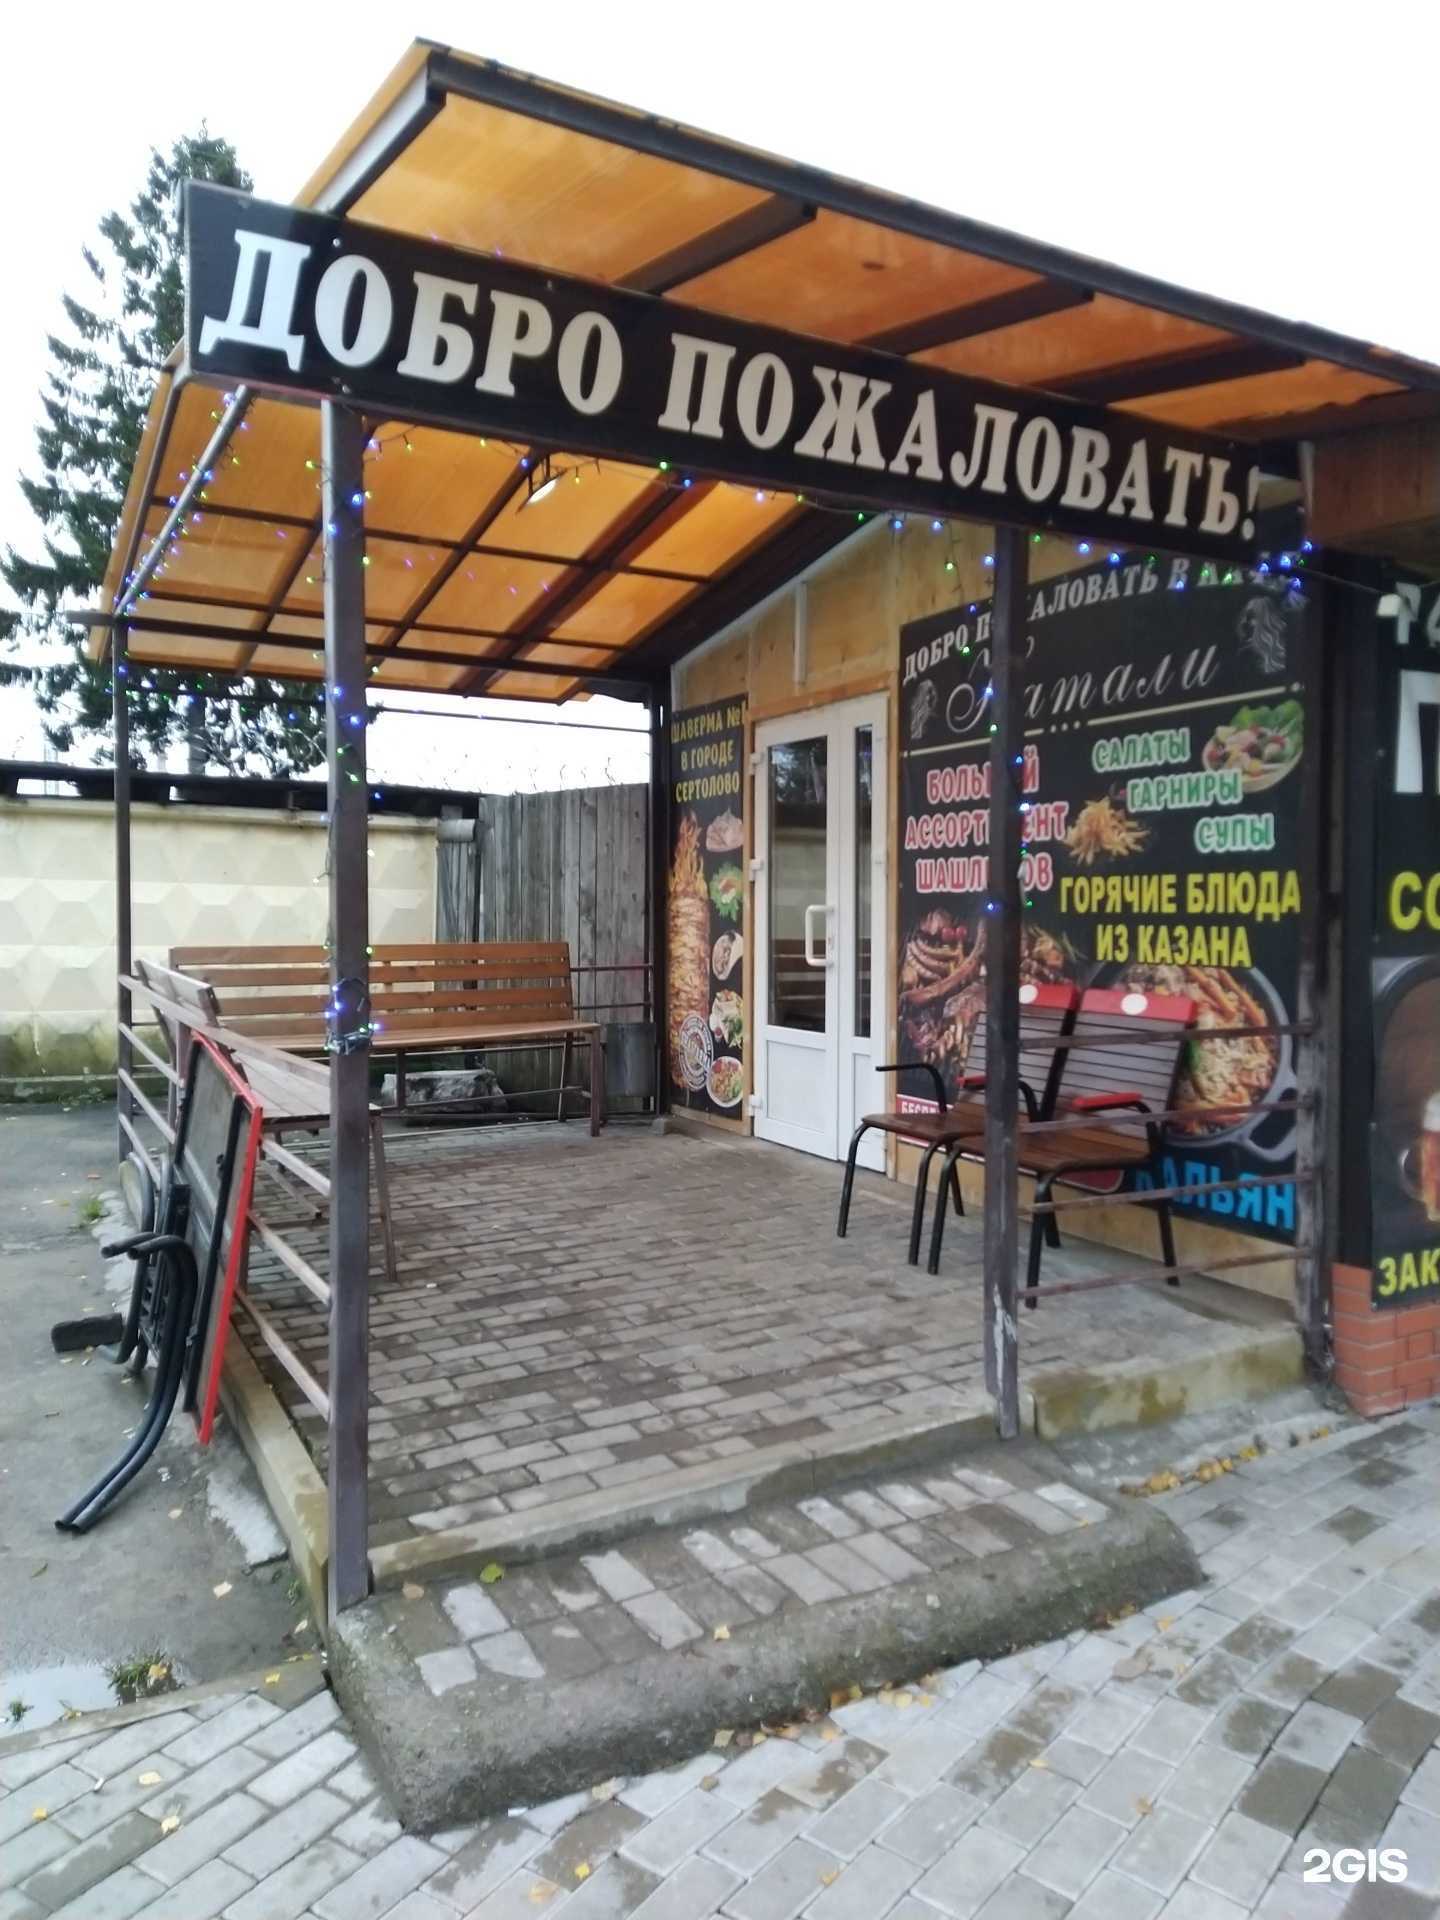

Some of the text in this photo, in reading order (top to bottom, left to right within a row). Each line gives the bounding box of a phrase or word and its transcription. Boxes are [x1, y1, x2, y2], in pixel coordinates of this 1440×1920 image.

[199, 229, 1260, 541] ДОБРО ПОЖАЛОВАТЬ!
[902, 624, 969, 686] ДОБРО
[975, 560, 1159, 643] ПАЛОВАТЬ
[671, 711, 723, 744] ШАВЕРМА
[691, 740, 734, 769] ГОРОДЕ
[1092, 727, 1191, 773] САЛАТЫ
[675, 771, 740, 803] СЕРТОЛОВО
[927, 744, 1039, 804] БОЛЬЙ
[1127, 769, 1243, 812] ГАРНИРЫ
[904, 801, 1069, 849] АССОРТЕНТ
[1194, 813, 1275, 853] СУПЫ
[916, 853, 1053, 893] ШАШЛОВ
[1060, 870, 1301, 922] ГОРЯЧИЕ БЛЮДА
[1096, 924, 1252, 967] ИЗ КАЗАНА
